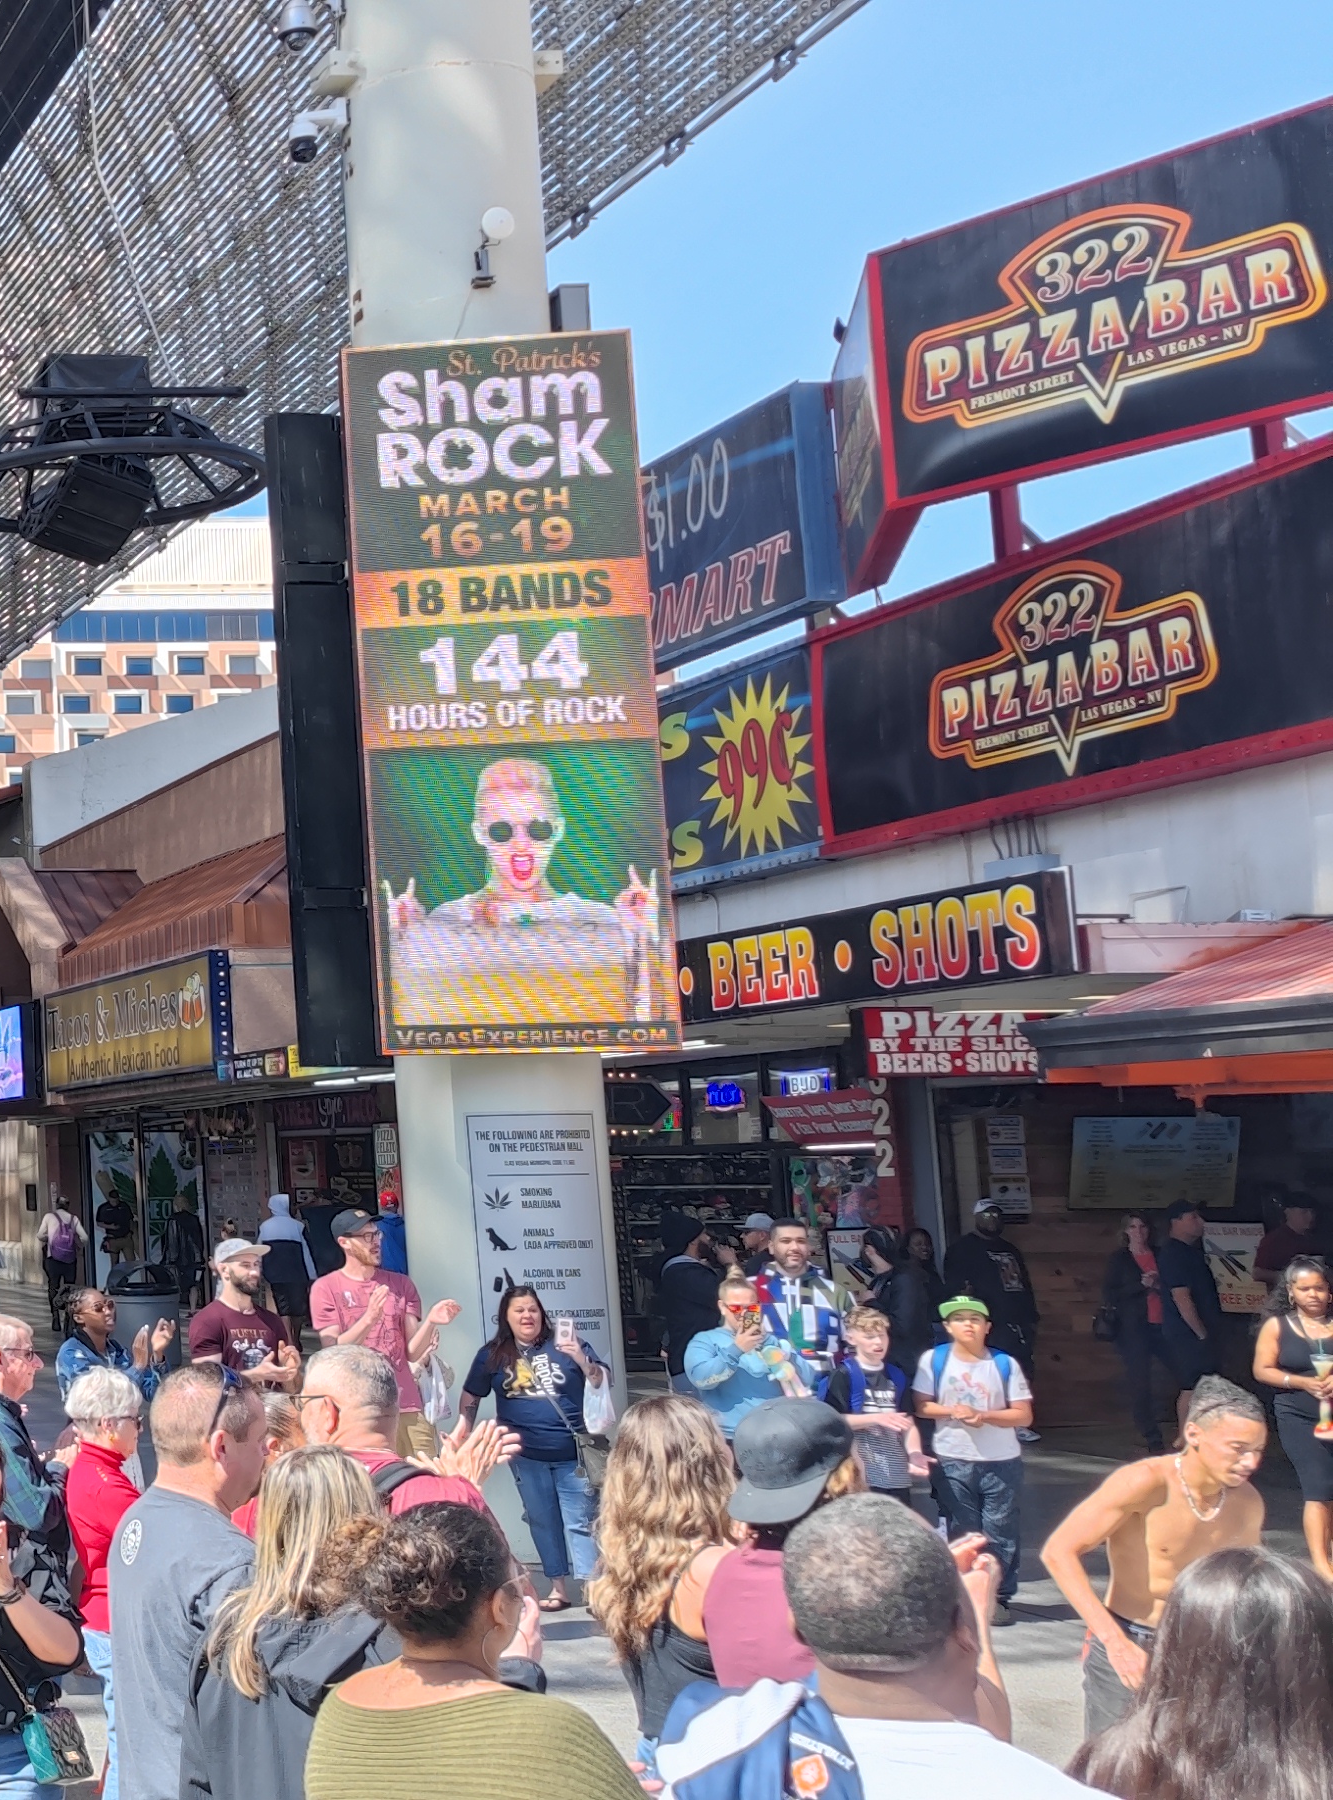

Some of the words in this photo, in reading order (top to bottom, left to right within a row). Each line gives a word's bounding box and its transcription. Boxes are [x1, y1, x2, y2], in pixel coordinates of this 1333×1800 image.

[1036, 225, 1151, 303] 322
[923, 296, 1128, 400] PIZZA
[1144, 241, 1295, 337] BAR
[446, 350, 483, 377] St.
[491, 343, 602, 374] Patrick's
[970, 384, 1025, 409] FREMONT
[1028, 370, 1074, 394] STREET
[1126, 350, 1153, 367] LAS
[1158, 334, 1207, 358] VEGAS
[1222, 323, 1243, 340] NV
[376, 369, 603, 431] Sham
[376, 418, 613, 489] ROCK
[418, 486, 571, 519] MARCH
[646, 436, 729, 573] $1.00
[419, 516, 574, 559] 16-19
[390, 579, 445, 617] 18
[459, 569, 613, 614] BANDS
[1018, 580, 1099, 650] 322
[418, 631, 589, 695] 144
[940, 660, 1075, 740] PIZZA
[1089, 615, 1195, 697] BAR
[387, 702, 488, 731] HOURS
[496, 700, 536, 727] OF
[543, 696, 627, 725] ROCK
[975, 729, 1016, 751] FREMONT
[1018, 717, 1050, 741] STREET
[1081, 704, 1104, 721] LAS
[1104, 697, 1135, 716] VEGAS
[1147, 689, 1163, 704] NV
[718, 707, 796, 830] 99¢
[708, 927, 820, 1013] BEER
[871, 884, 1041, 990] SHOTS
[47, 1007, 90, 1052] Tacos
[95, 996, 110, 1043] &
[113, 980, 177, 1039] Miches
[880, 1011, 1028, 1037] PIZZA
[70, 1053, 111, 1081] Authentic
[113, 1048, 152, 1075] Mexican
[155, 1038, 180, 1067] Food
[869, 1038, 901, 1052] BY
[910, 1038, 962, 1051] THE
[971, 1037, 1035, 1051] SLIC
[877, 1053, 952, 1073] BEERS
[965, 1051, 1038, 1073] SHOTS
[790, 1074, 820, 1095] BUD
[376, 1129, 393, 1141] PIZZA
[475, 1131, 491, 1140] THE
[493, 1130, 537, 1140] FOLLOWING
[540, 1130, 554, 1139] ARE
[555, 1129, 590, 1139] PROHIBITED
[489, 1142, 500, 1152] ON
[501, 1142, 518, 1152] THE
[519, 1142, 566, 1152] PEDESTRIAN
[520, 1188, 553, 1197] SMOKING
[521, 1200, 561, 1209] MARIJUANA
[523, 1228, 554, 1237] ANIMALS
[523, 1269, 554, 1278] ALCOHOL
[556, 1269, 563, 1277] IN
[565, 1268, 581, 1277] CANS
[535, 1281, 566, 1290] BOTTLES
